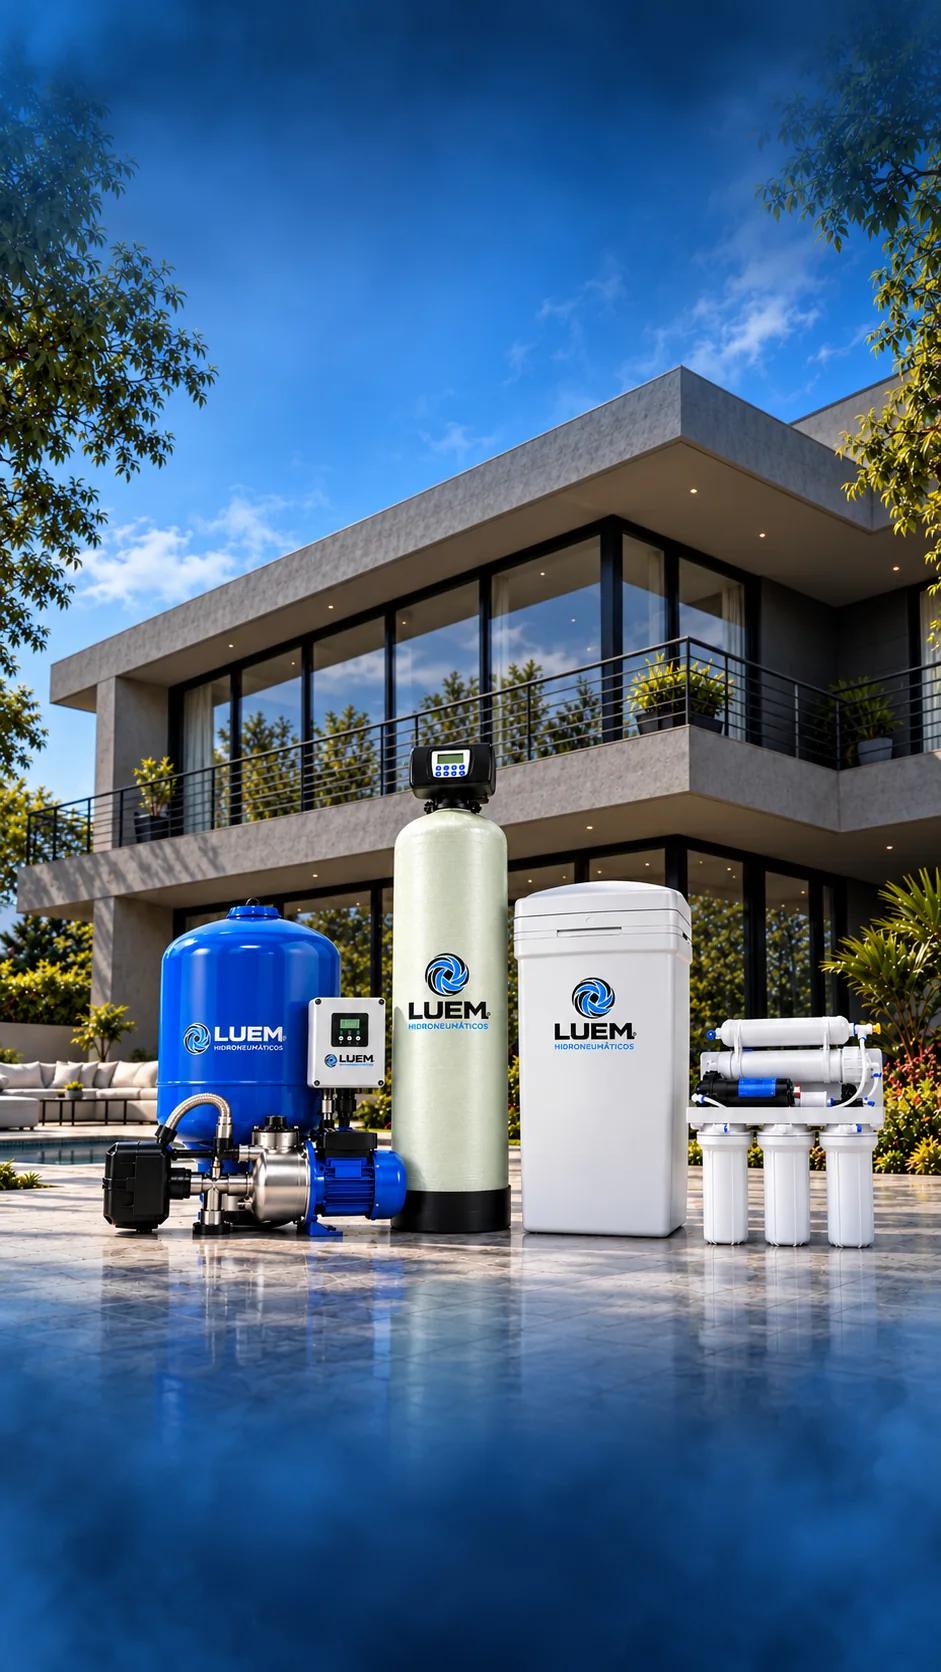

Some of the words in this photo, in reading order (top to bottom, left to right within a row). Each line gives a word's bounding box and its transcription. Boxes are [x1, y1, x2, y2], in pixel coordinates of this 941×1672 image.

[407, 1001, 488, 1020] LUEM
[408, 1022, 488, 1030] HIDRONEUMÁTICOS
[554, 1022, 635, 1040] LUEM
[214, 1026, 283, 1042] LUEM
[554, 1042, 634, 1050] HIDRONEUMÁTICOS
[339, 1054, 374, 1063] LUEM
